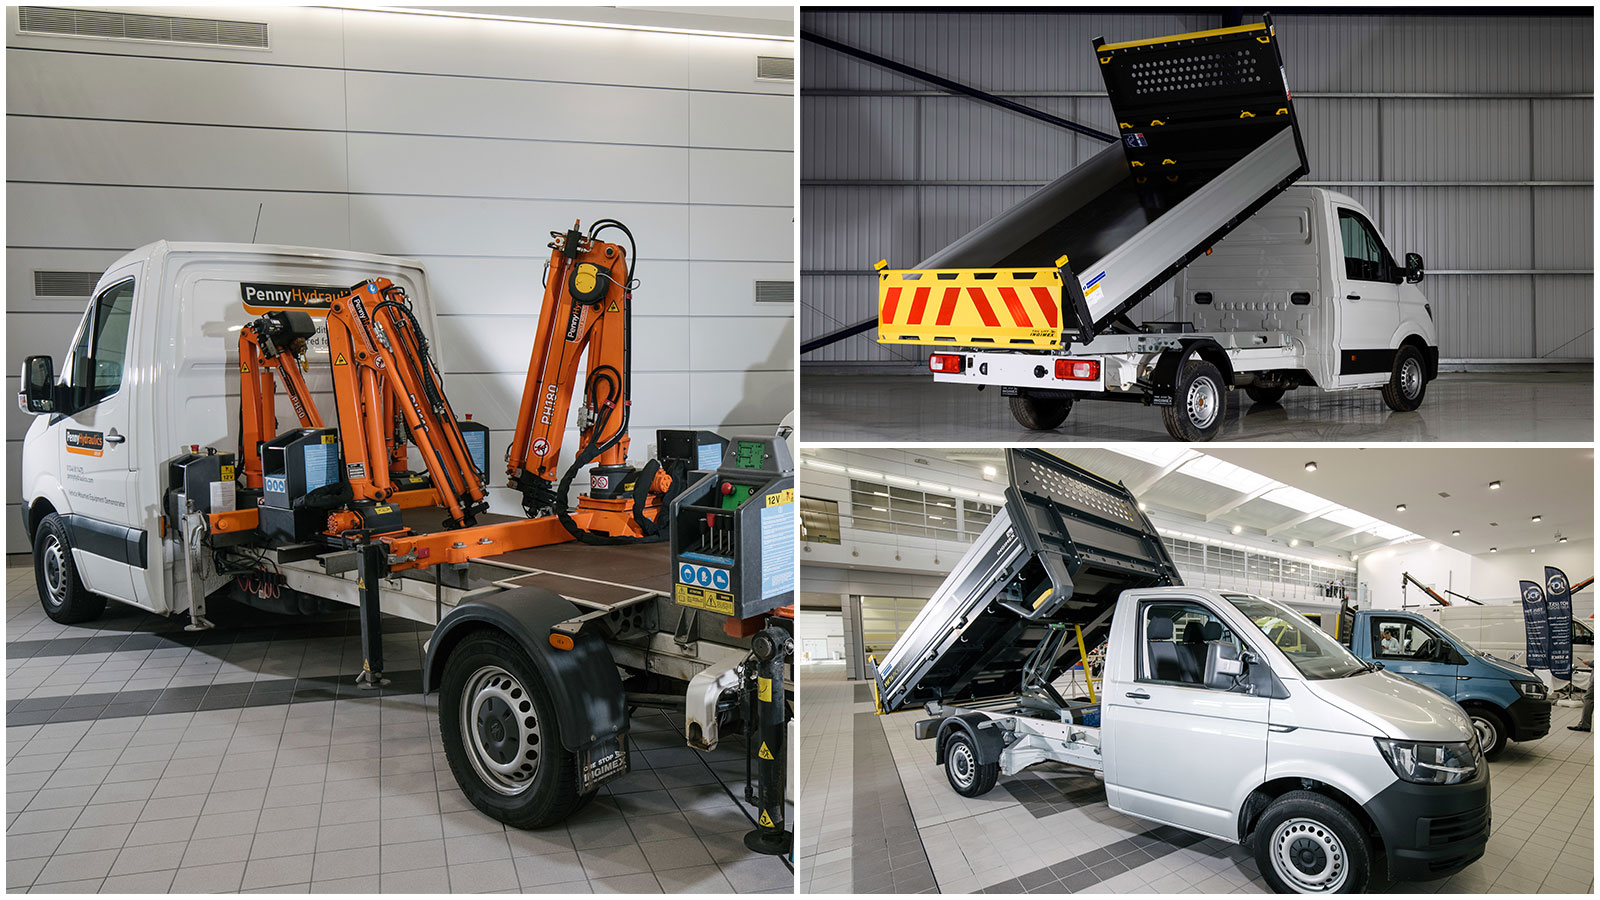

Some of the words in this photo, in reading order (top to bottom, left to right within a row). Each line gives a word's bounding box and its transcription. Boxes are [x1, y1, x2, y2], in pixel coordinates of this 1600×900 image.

[245, 286, 348, 305] PennyHydraul
[292, 396, 305, 419] PH50
[541, 384, 559, 425] PH180
[768, 495, 781, 505] 12V
[598, 754, 614, 766] STOP
